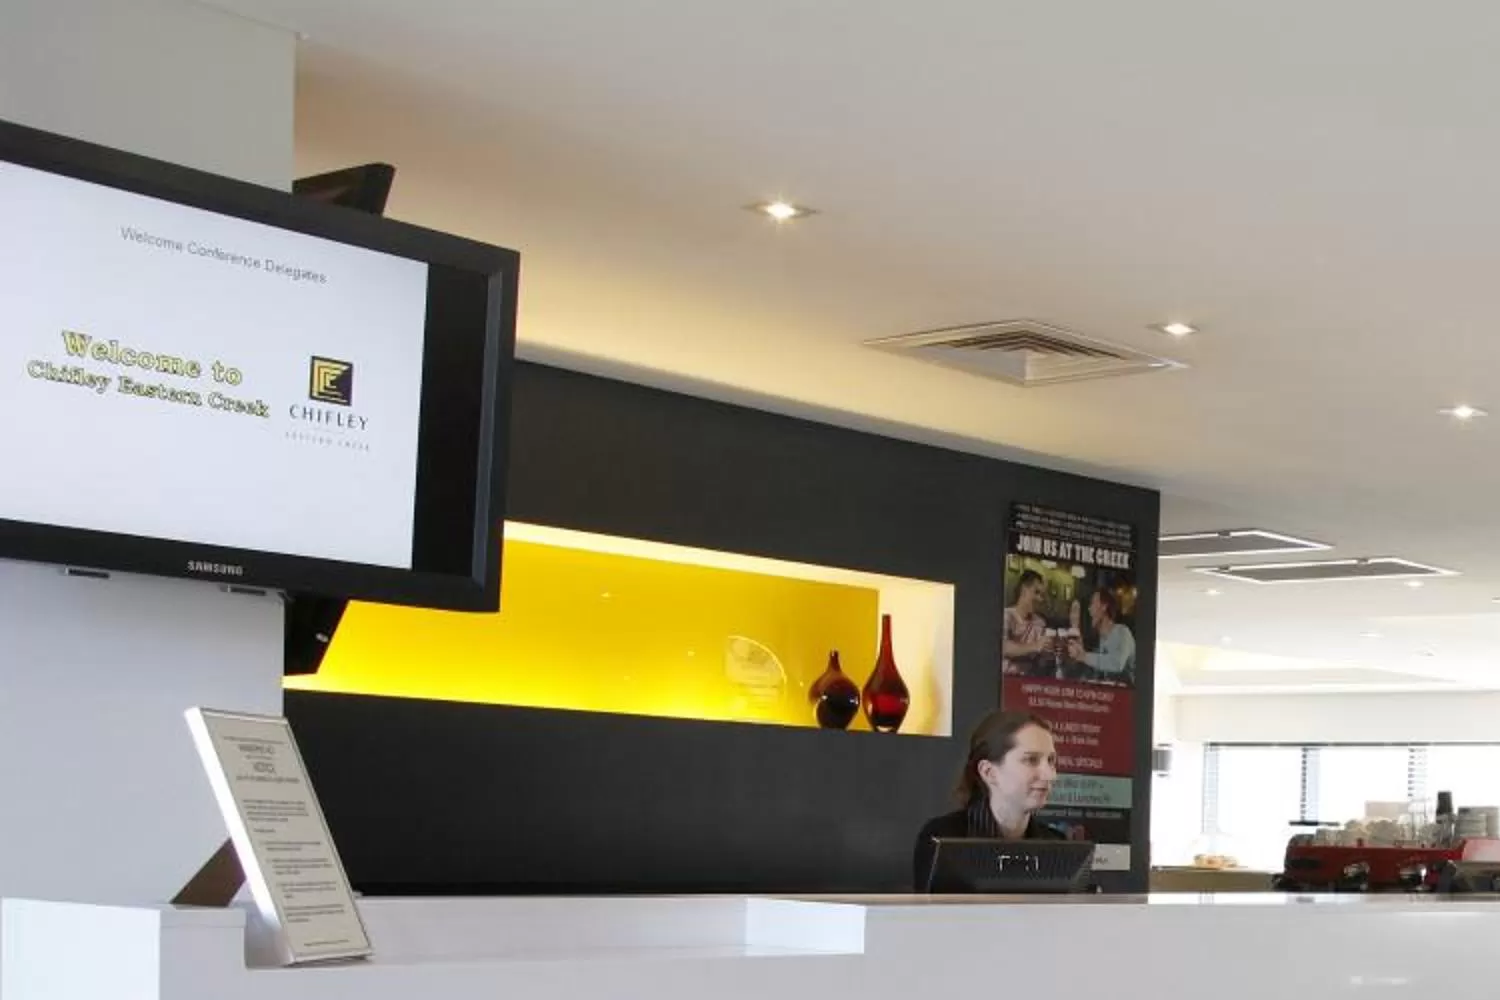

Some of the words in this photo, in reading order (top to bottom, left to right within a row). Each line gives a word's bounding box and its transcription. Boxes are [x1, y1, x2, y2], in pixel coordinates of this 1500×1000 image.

[120, 226, 183, 252] Welcome
[187, 240, 261, 268] Conference
[263, 258, 328, 284] Delegates
[61, 329, 202, 378] Welcome
[211, 360, 243, 386] to
[27, 360, 112, 394] Chifley
[117, 376, 203, 406] Eastern
[207, 391, 270, 418] Creek
[289, 404, 369, 431] CHIFLEY
[187, 560, 244, 576] SAMSUNG
[1016, 533, 1042, 555] JOIN
[1043, 538, 1058, 557] US
[1059, 541, 1073, 560] AT
[1075, 544, 1095, 564] THE
[1096, 547, 1130, 569] CREEK
